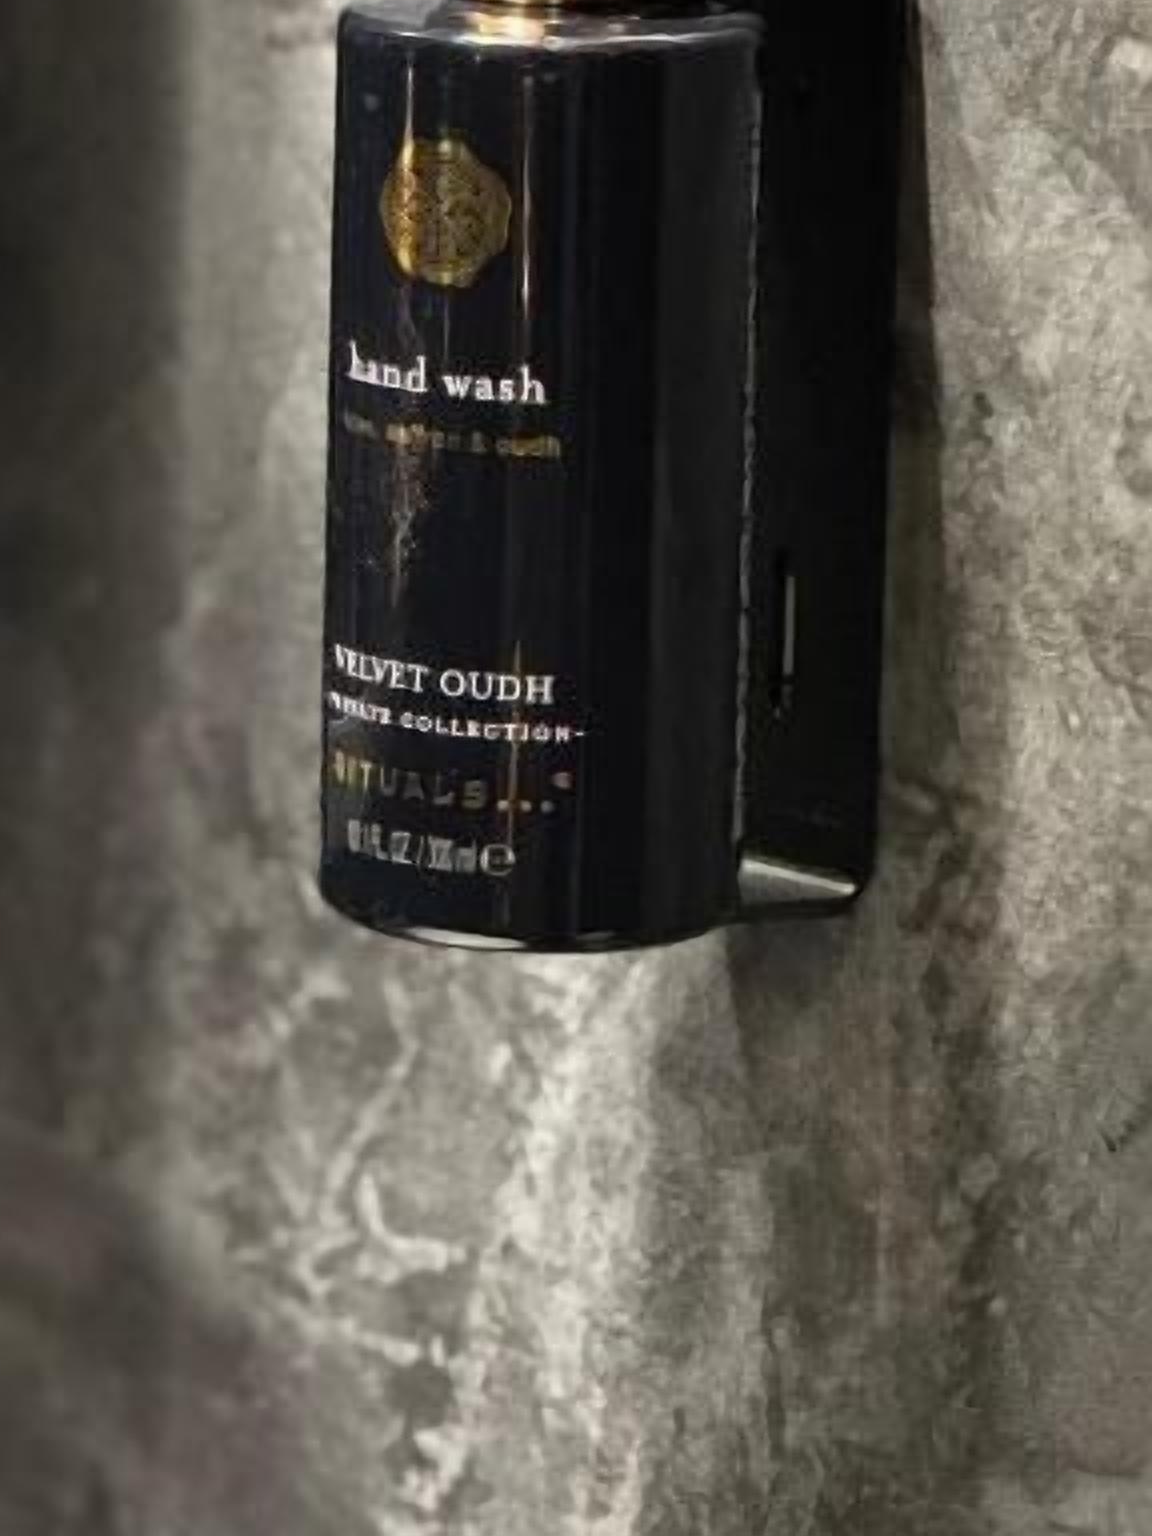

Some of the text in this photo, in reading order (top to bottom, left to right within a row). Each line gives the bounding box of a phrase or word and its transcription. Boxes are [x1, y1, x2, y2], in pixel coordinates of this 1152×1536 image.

[441, 364, 551, 405] wash
[334, 642, 556, 704] VELVET OUDH
